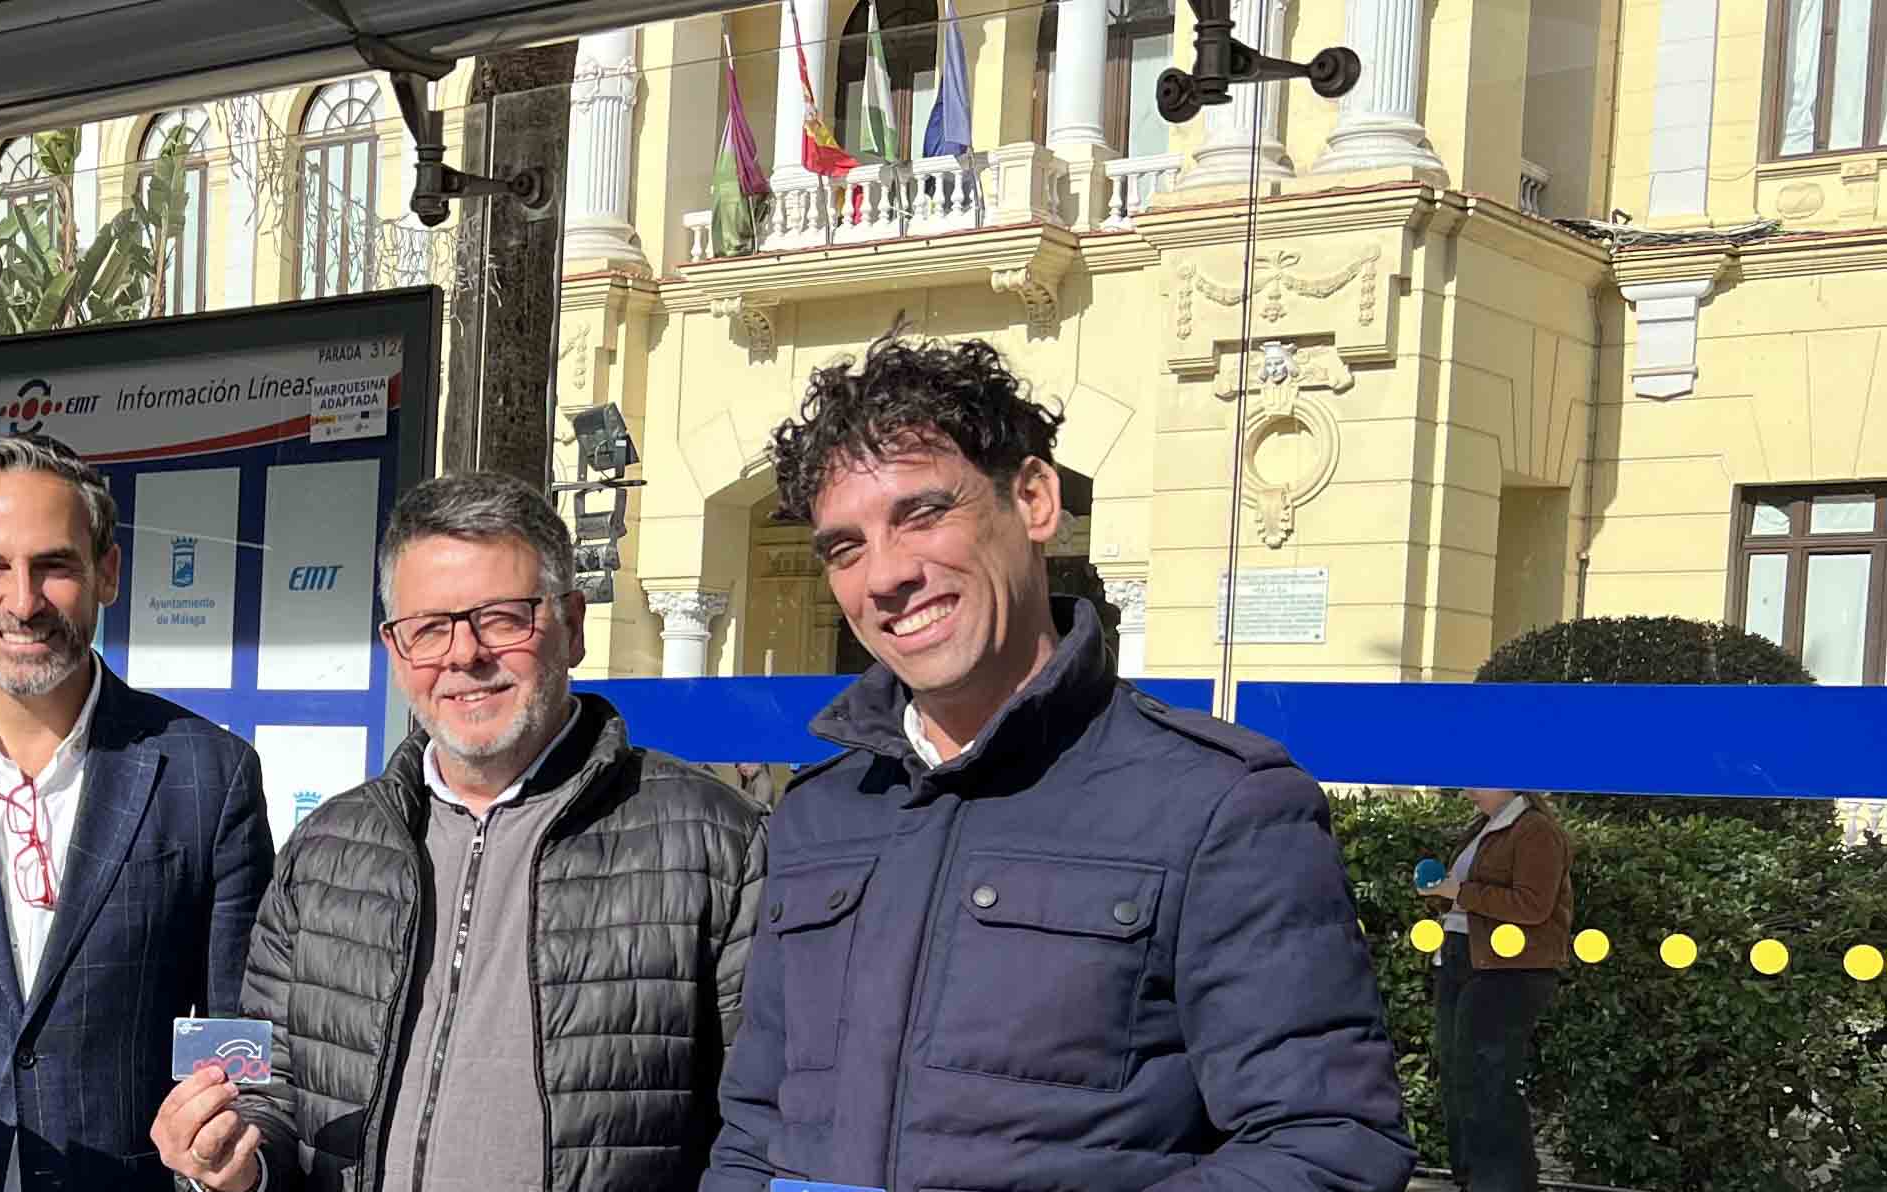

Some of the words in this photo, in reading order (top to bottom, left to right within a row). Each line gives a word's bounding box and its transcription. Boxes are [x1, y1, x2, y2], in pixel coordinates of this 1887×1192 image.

[318, 344, 362, 364] PARADA
[65, 394, 101, 415] EMT
[116, 377, 240, 412] Información
[247, 374, 315, 401] Líneas
[314, 378, 386, 398] MARQUESINA
[321, 393, 378, 409] ADAPTADA
[289, 564, 344, 591] EMT
